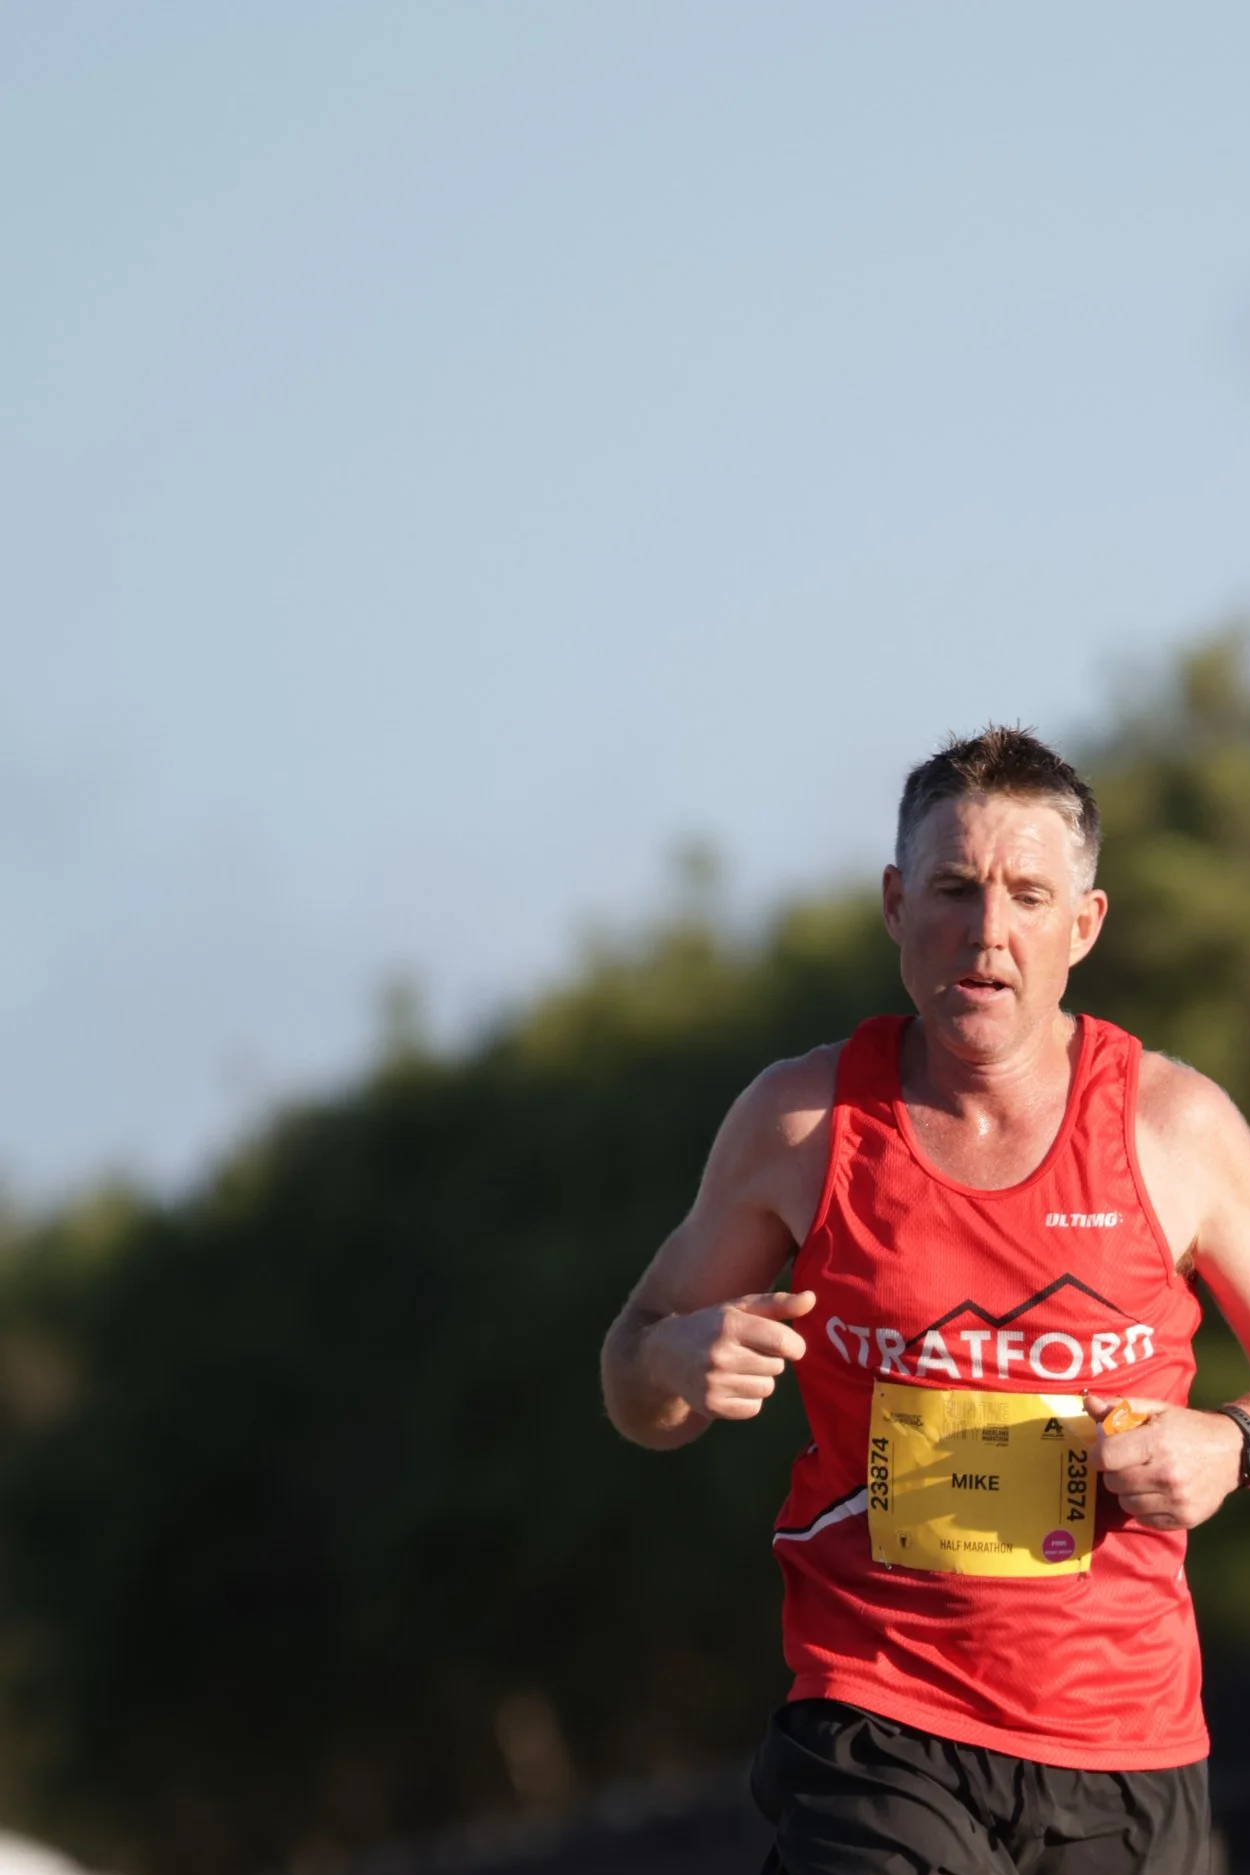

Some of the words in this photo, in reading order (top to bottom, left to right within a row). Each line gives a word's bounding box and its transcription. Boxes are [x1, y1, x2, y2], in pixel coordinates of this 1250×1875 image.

[826, 1315, 1154, 1381] STRATFORD
[871, 1437, 889, 1512] 23874
[951, 1473, 1000, 1491] MIKE
[1066, 1448, 1087, 1522] 23874
[940, 1539, 961, 1551] HALF
[963, 1541, 1013, 1554] MARATHON
